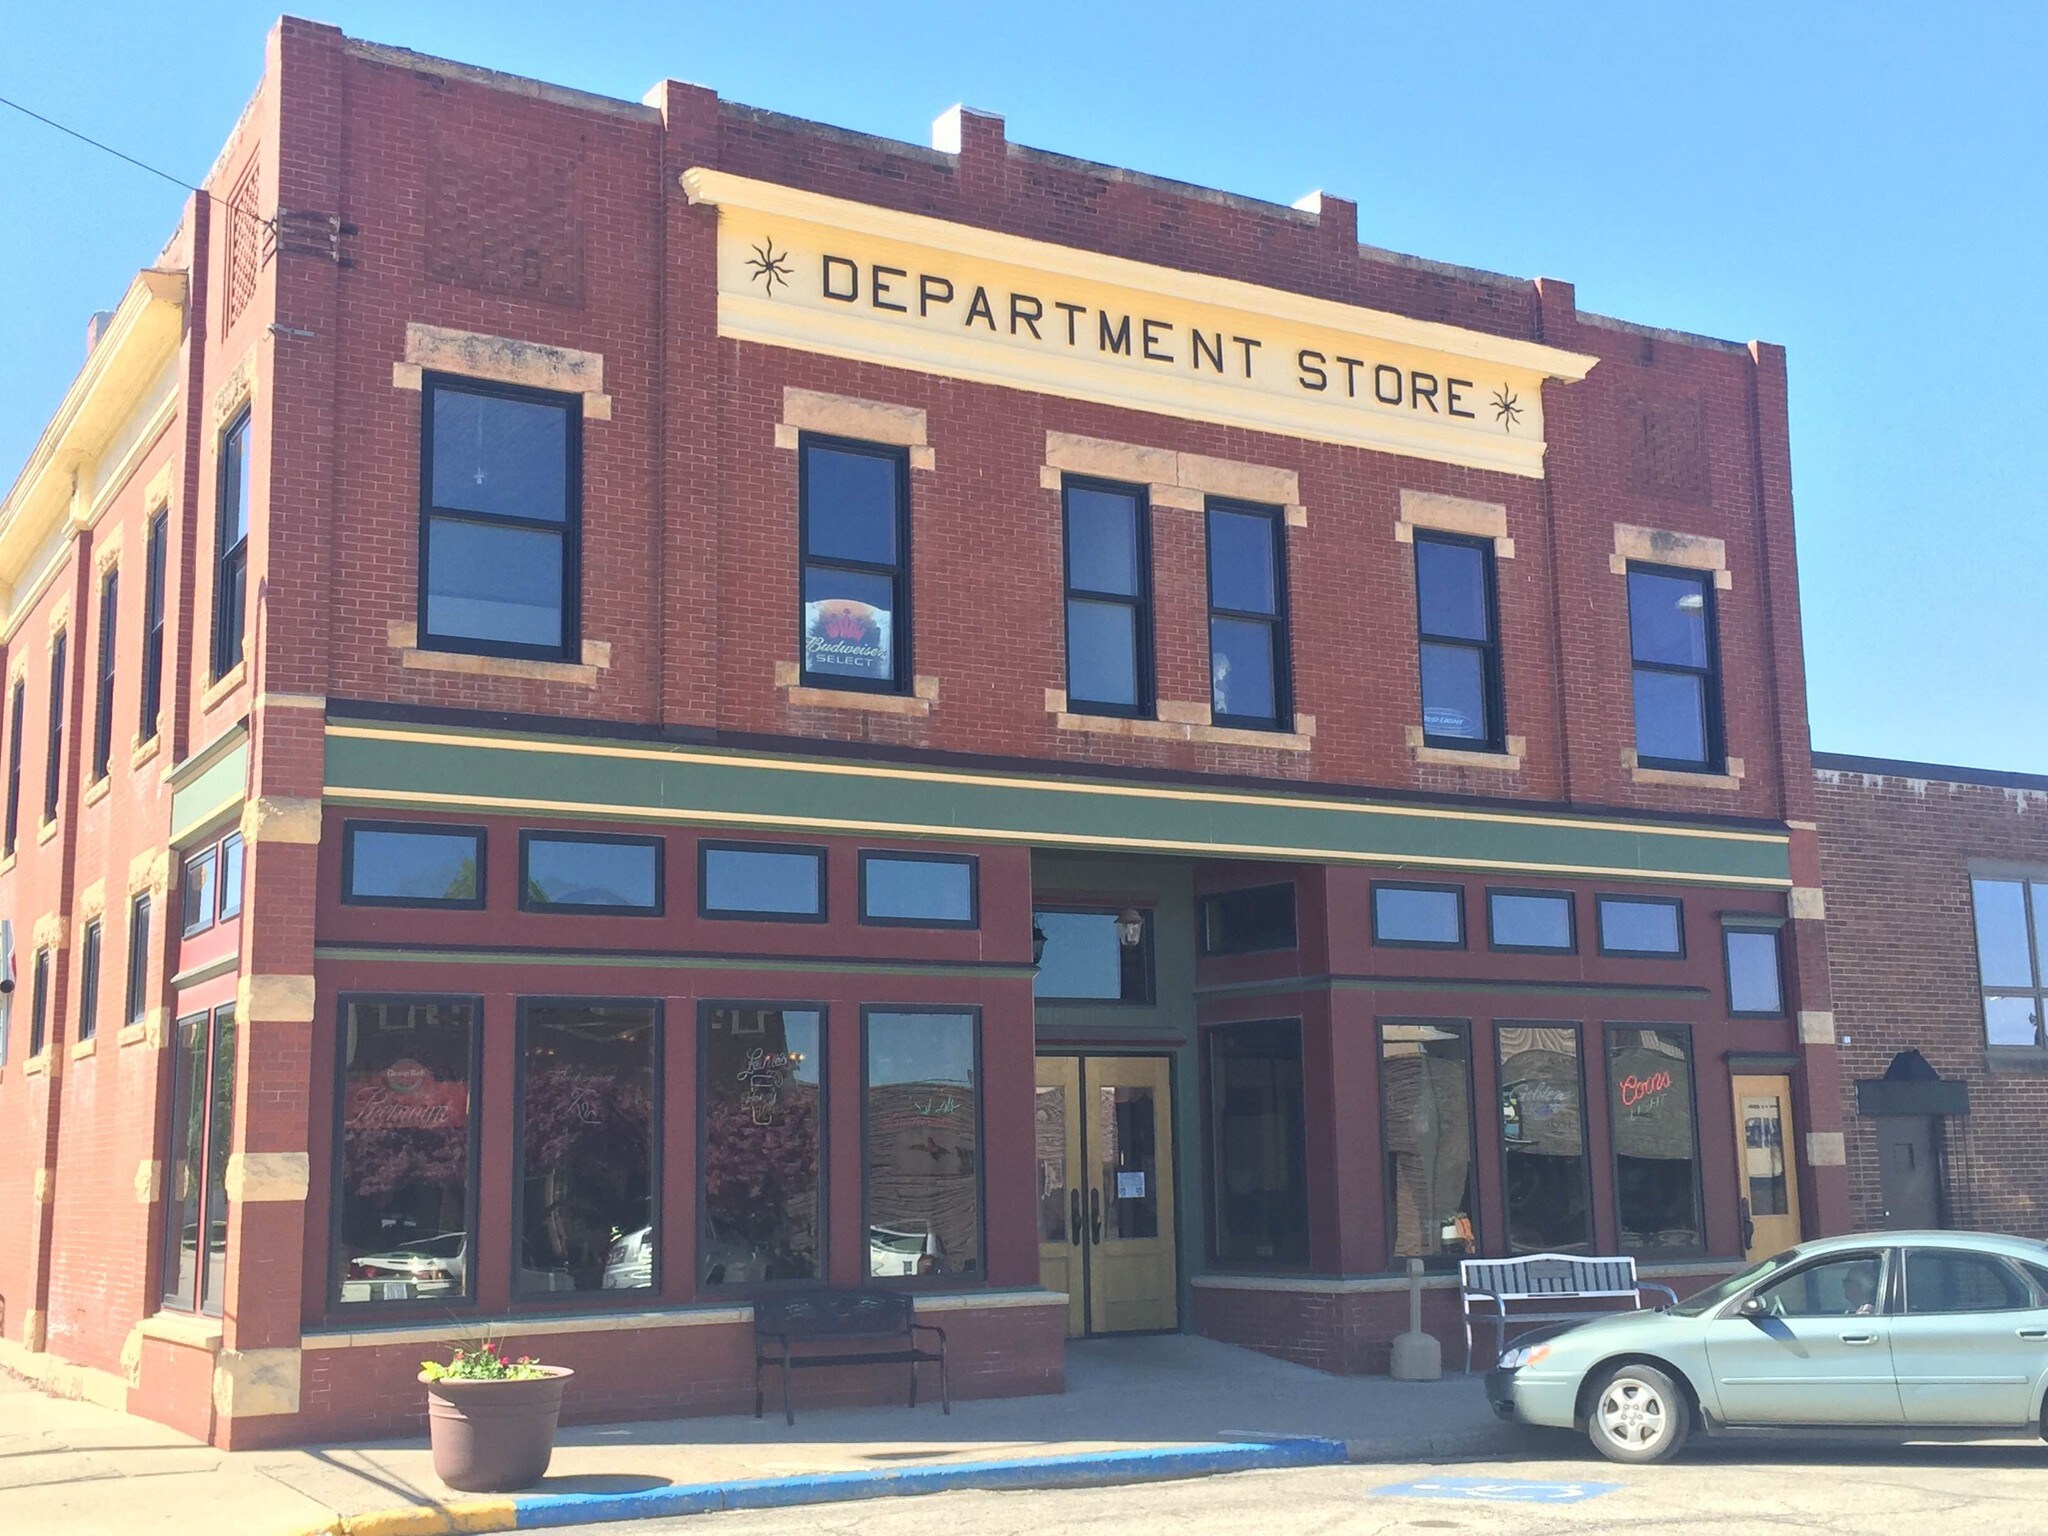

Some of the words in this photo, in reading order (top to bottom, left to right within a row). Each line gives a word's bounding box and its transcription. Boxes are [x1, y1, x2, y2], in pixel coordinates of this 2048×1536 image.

[822, 254, 1263, 379] DEPARTMENT
[1298, 349, 1477, 420] STORE
[806, 636, 887, 658] Budweiser
[815, 654, 874, 667] SELECT
[1439, 716, 1464, 725] LIGHT
[1619, 1070, 1673, 1106] Coors
